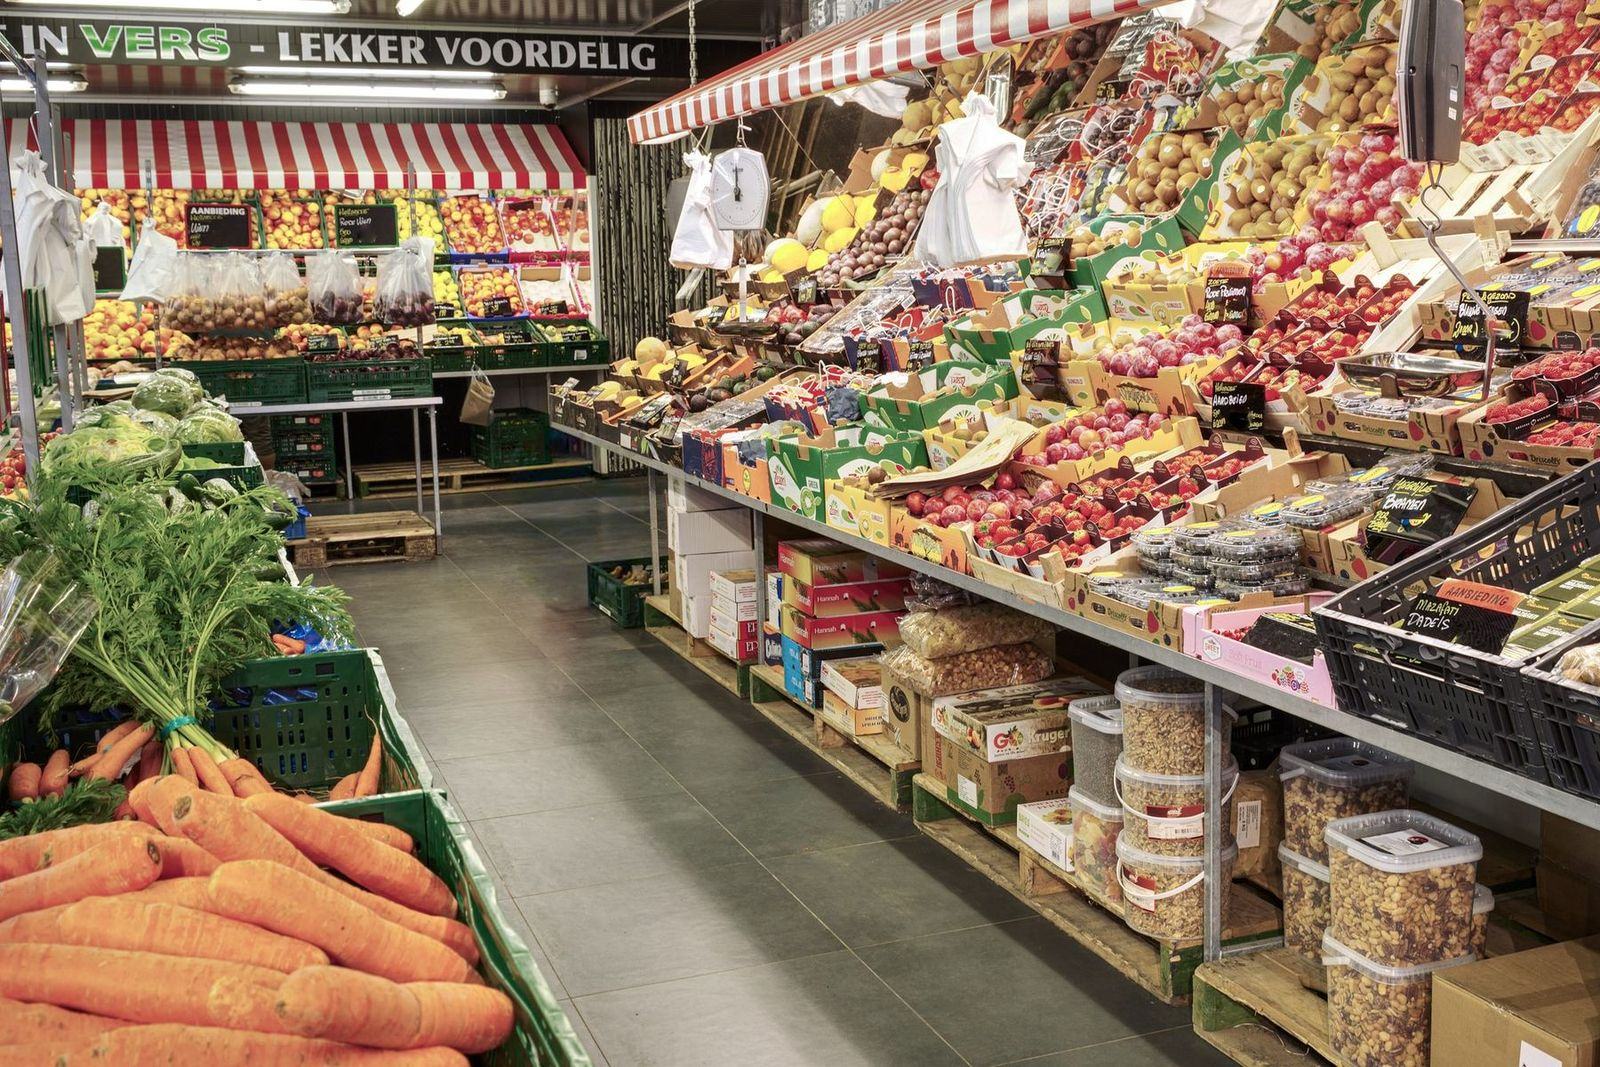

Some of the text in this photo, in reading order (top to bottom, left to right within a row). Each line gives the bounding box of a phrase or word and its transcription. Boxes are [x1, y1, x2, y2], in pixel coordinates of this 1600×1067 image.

[22, 25, 69, 56] IN
[79, 24, 230, 61] VERS
[278, 31, 427, 64] LEKKER
[435, 37, 656, 71] VOORDELIG
[190, 207, 246, 216] AANBIEDING
[817, 594, 840, 603] Hannah
[1446, 586, 1510, 606] AANBIEDING
[814, 626, 837, 635] Hannah
[1029, 729, 1070, 744] Kruger
